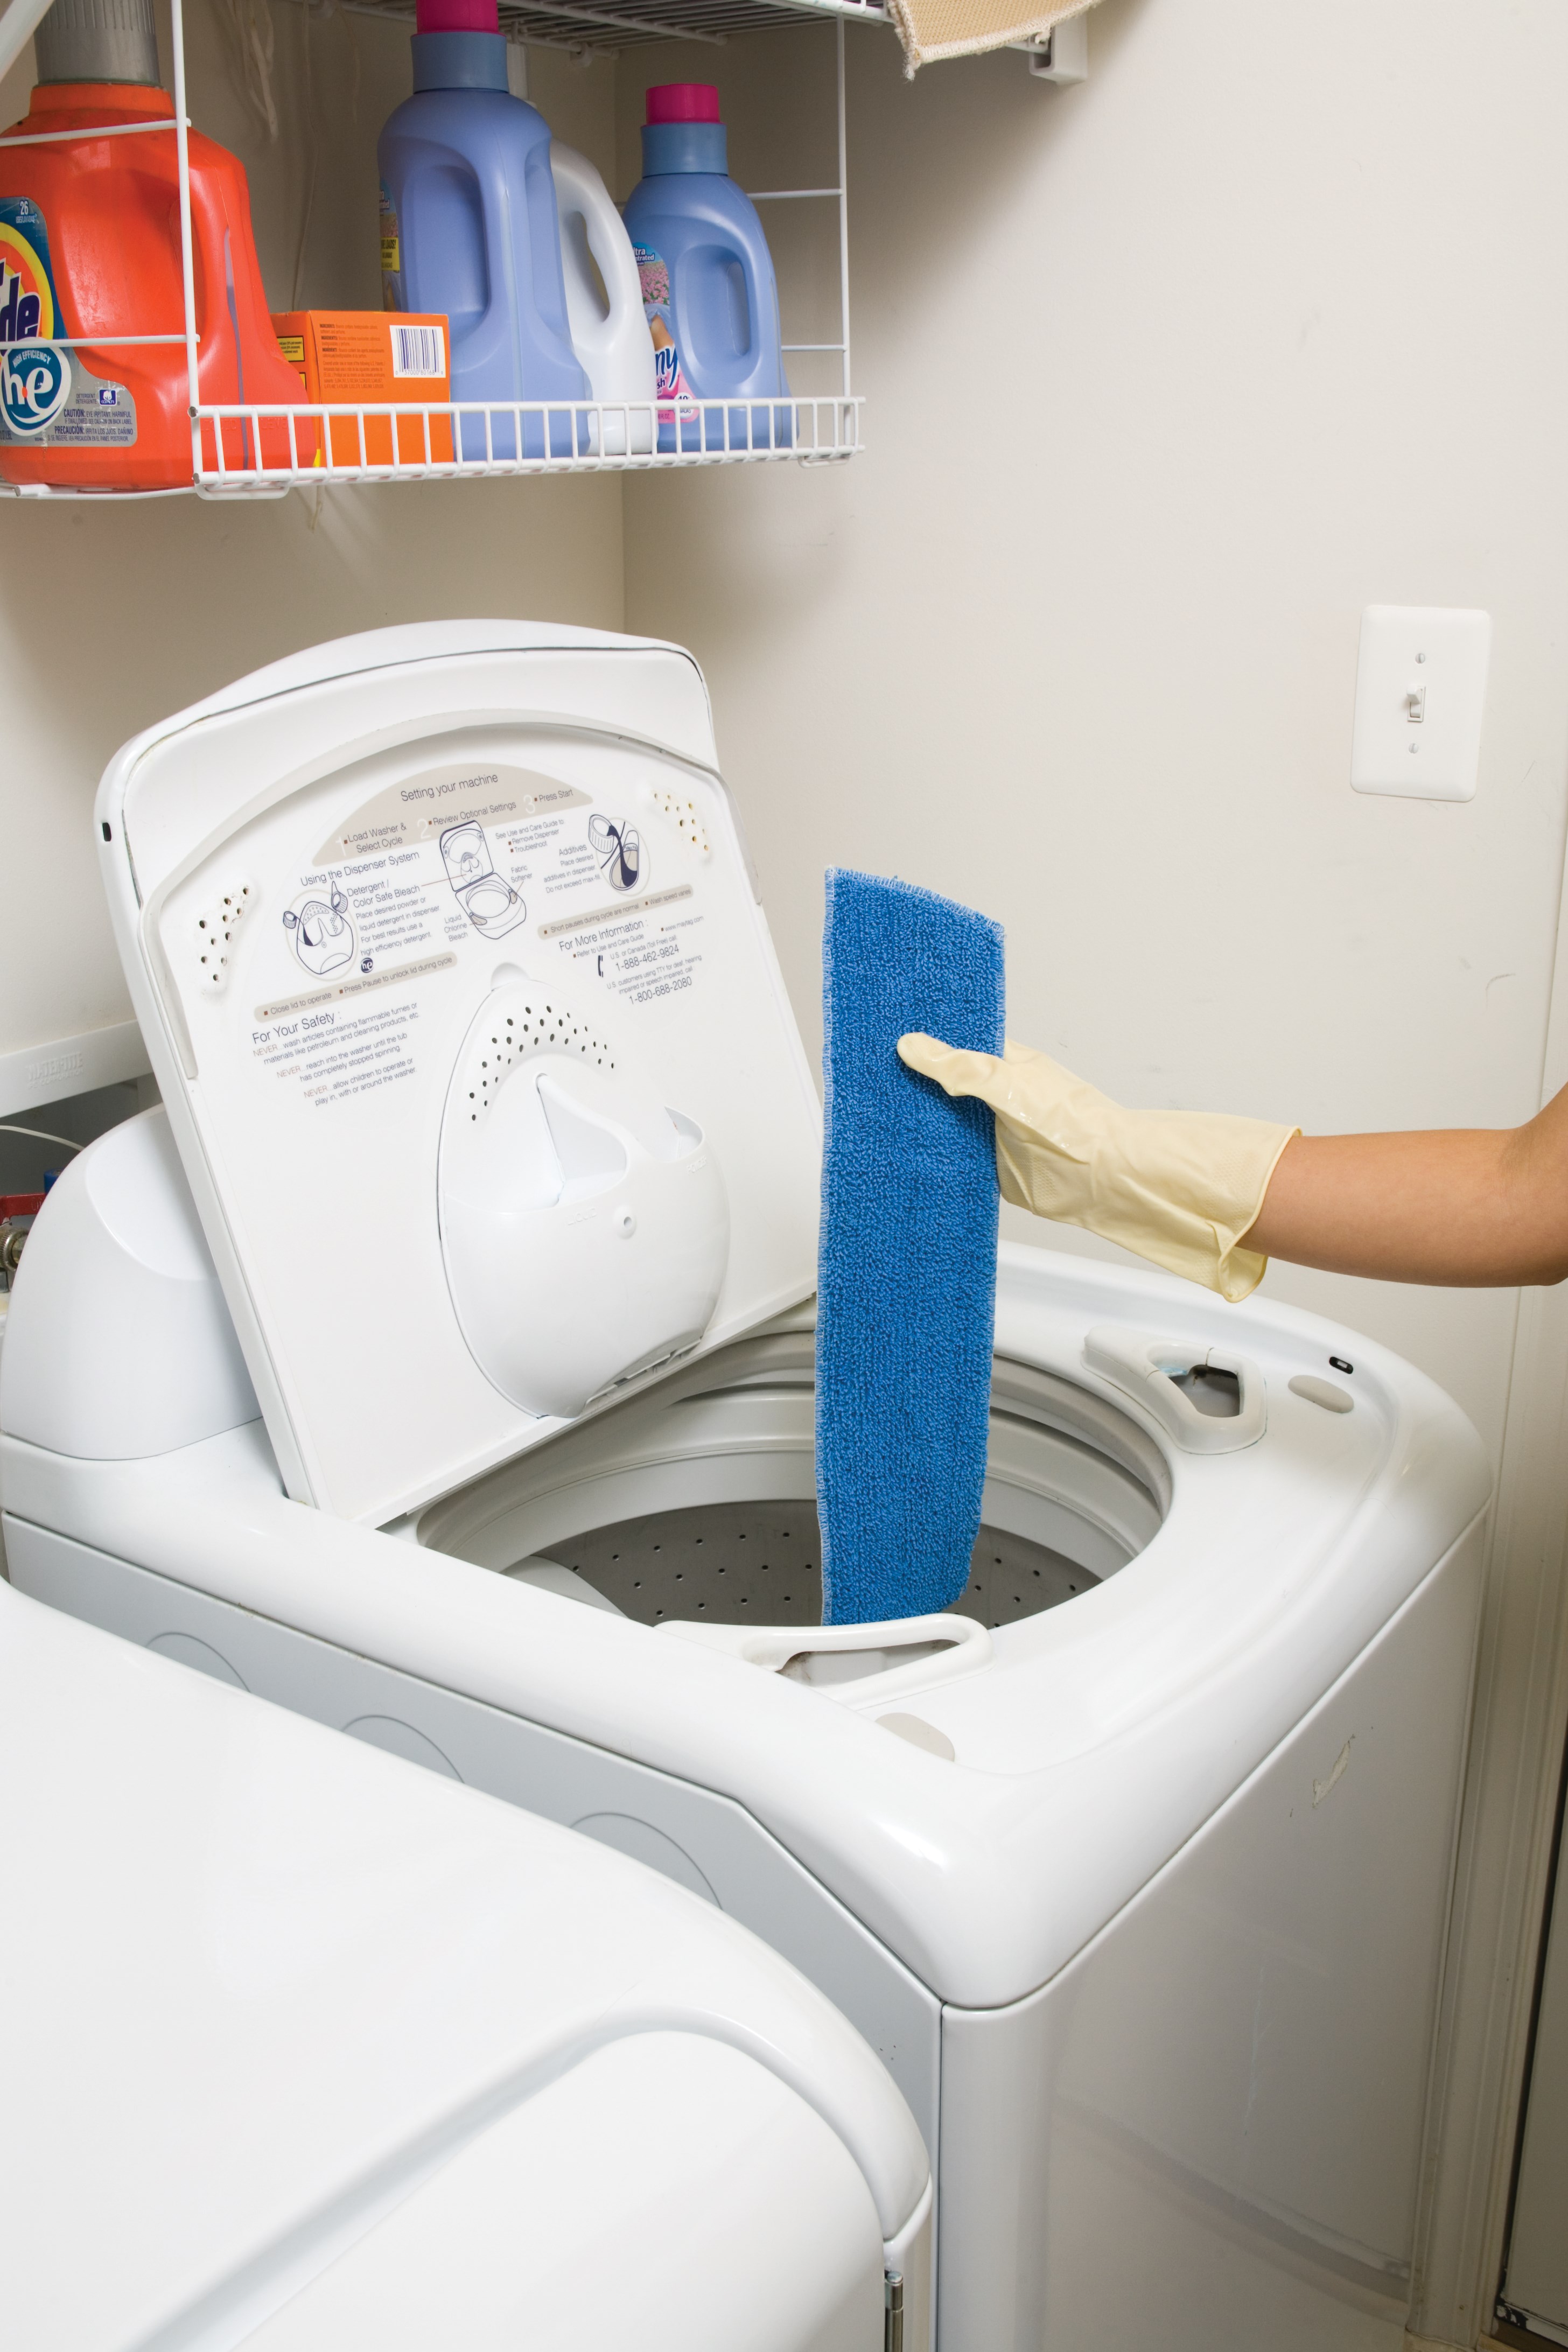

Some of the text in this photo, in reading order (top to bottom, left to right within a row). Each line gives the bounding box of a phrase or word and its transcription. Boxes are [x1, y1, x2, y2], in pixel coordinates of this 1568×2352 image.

[20, 200, 29, 215] 26
[12, 349, 51, 368] HIGH EFFICIENCY
[6, 363, 53, 414] he
[64, 409, 86, 418] CAUTION:
[55, 425, 85, 434] PRECAUCIÓN:
[401, 774, 498, 801] Setting your machine
[538, 788, 573, 802] Press Start
[432, 802, 516, 825] Review Optional Settings
[347, 822, 407, 842] Load Washer &
[512, 829, 559, 844] Remove Dispenser
[356, 836, 403, 853] Select Cycle
[515, 840, 547, 852] Troubleshoot
[559, 844, 587, 856] Additives
[575, 853, 593, 863] desired
[300, 852, 419, 886] Using the Dispenser System
[510, 865, 528, 873] Fabric
[510, 873, 532, 883] Softener
[543, 872, 565, 883] additives
[346, 880, 385, 897] Detergent
[563, 878, 582, 888] exceed
[353, 885, 420, 908] Color Safe Bleach
[355, 911, 373, 920] Place
[374, 904, 396, 915] desired
[396, 899, 418, 910] powder
[359, 921, 376, 931] liquid
[376, 914, 405, 927] detergent
[444, 913, 461, 927] Liquid
[444, 922, 467, 933] Chlorine
[372, 931, 386, 940] best
[386, 927, 405, 936] results
[448, 931, 468, 942] Bleach
[558, 920, 643, 951] For More Information
[360, 947, 374, 958] high
[375, 940, 402, 952] efficiency
[576, 949, 590, 957] Refer
[607, 941, 617, 949] and
[629, 934, 644, 942] Guide
[361, 959, 373, 970] he
[615, 943, 679, 971] 1-888-462-9824
[344, 984, 362, 993] Press
[362, 978, 381, 988] Pause
[389, 969, 409, 980] unlock
[418, 962, 437, 971] during
[437, 957, 452, 966] cycle
[629, 976, 691, 1004] 1-800-688-2080
[270, 1005, 289, 1014] Close
[290, 1000, 298, 1009] lid
[307, 992, 332, 1004] operate
[252, 1012, 334, 1044] For Your Safety
[302, 1031, 325, 1042] articles
[325, 1021, 358, 1035] containing
[358, 1011, 390, 1025] flammable
[391, 1005, 410, 1015] fumes
[263, 1051, 294, 1064] materials
[294, 1047, 305, 1055] like
[306, 1037, 339, 1053] petroleum
[340, 1032, 353, 1041] and
[353, 1025, 379, 1037] cleaning
[380, 1016, 408, 1030] products,
[325, 1055, 337, 1063] into
[349, 1044, 372, 1055] washer
[373, 1038, 386, 1048] until
[386, 1036, 396, 1044] the
[396, 1032, 407, 1040] tub
[299, 1074, 312, 1082] has
[313, 1062, 347, 1077] completely
[348, 1052, 374, 1066] stopped
[350, 1071, 374, 1083] children
[382, 1060, 405, 1073] operate
[314, 1096, 328, 1107] play
[338, 1088, 351, 1097] with
[360, 1077, 382, 1090] around
[382, 1072, 393, 1082] the
[566, 1207, 597, 1226] LIQUID
